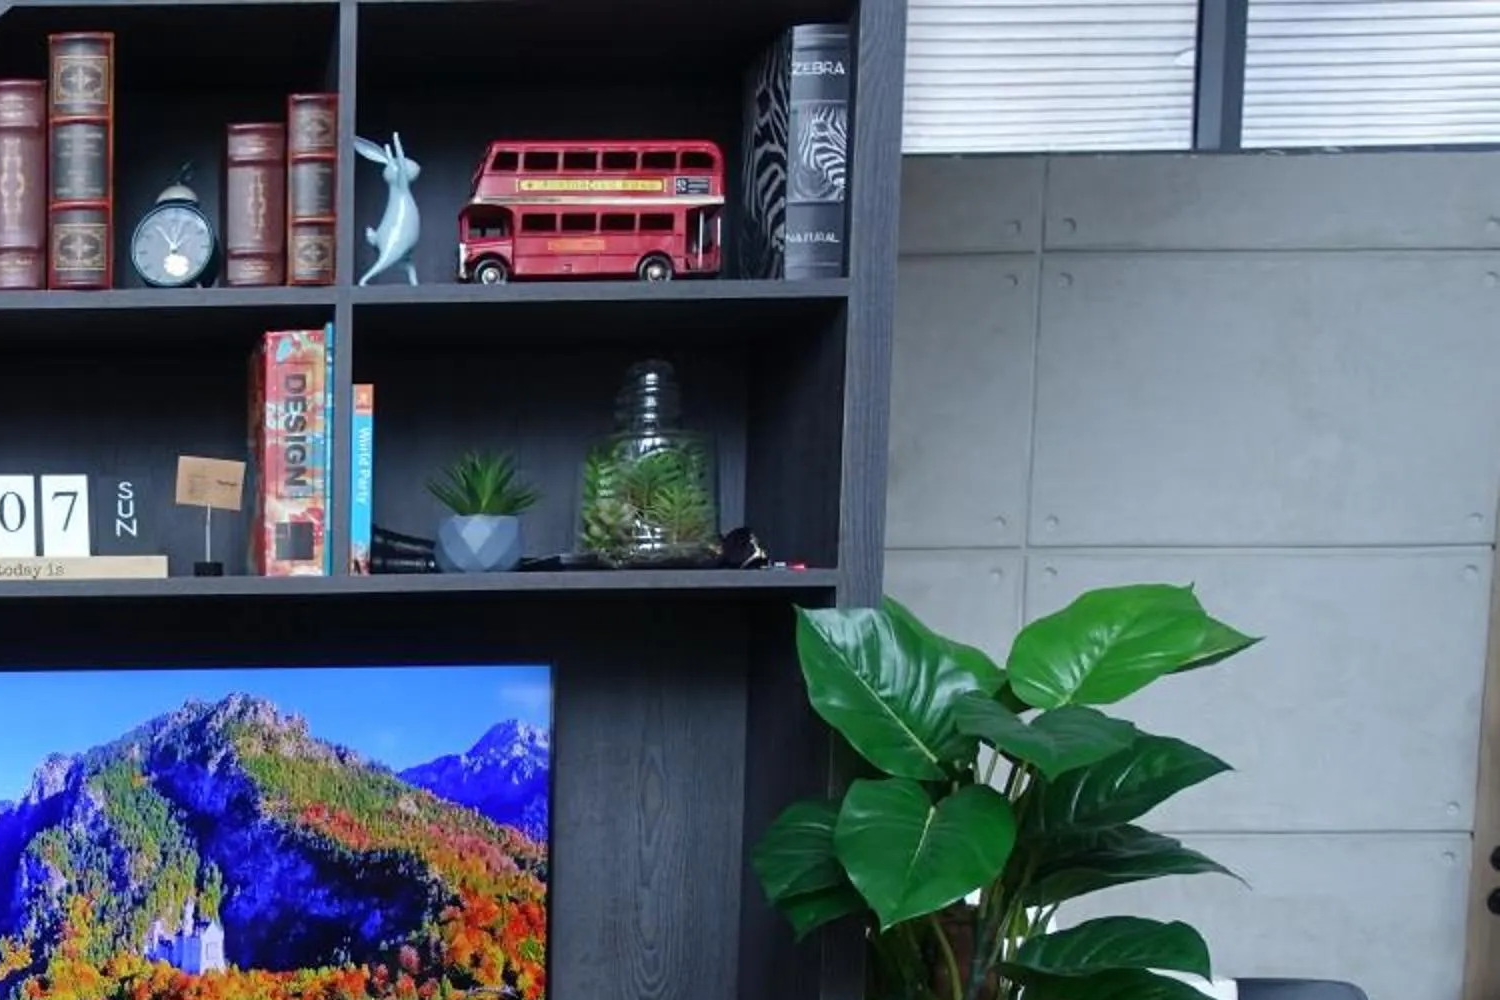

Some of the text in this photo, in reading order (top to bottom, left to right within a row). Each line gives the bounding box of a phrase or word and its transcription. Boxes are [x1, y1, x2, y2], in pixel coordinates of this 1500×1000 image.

[792, 60, 846, 76] ZEBRA
[785, 231, 841, 244] NATURAL
[284, 373, 307, 487] DESIGN
[115, 481, 138, 538] SUN
[46, 562, 65, 577] is
